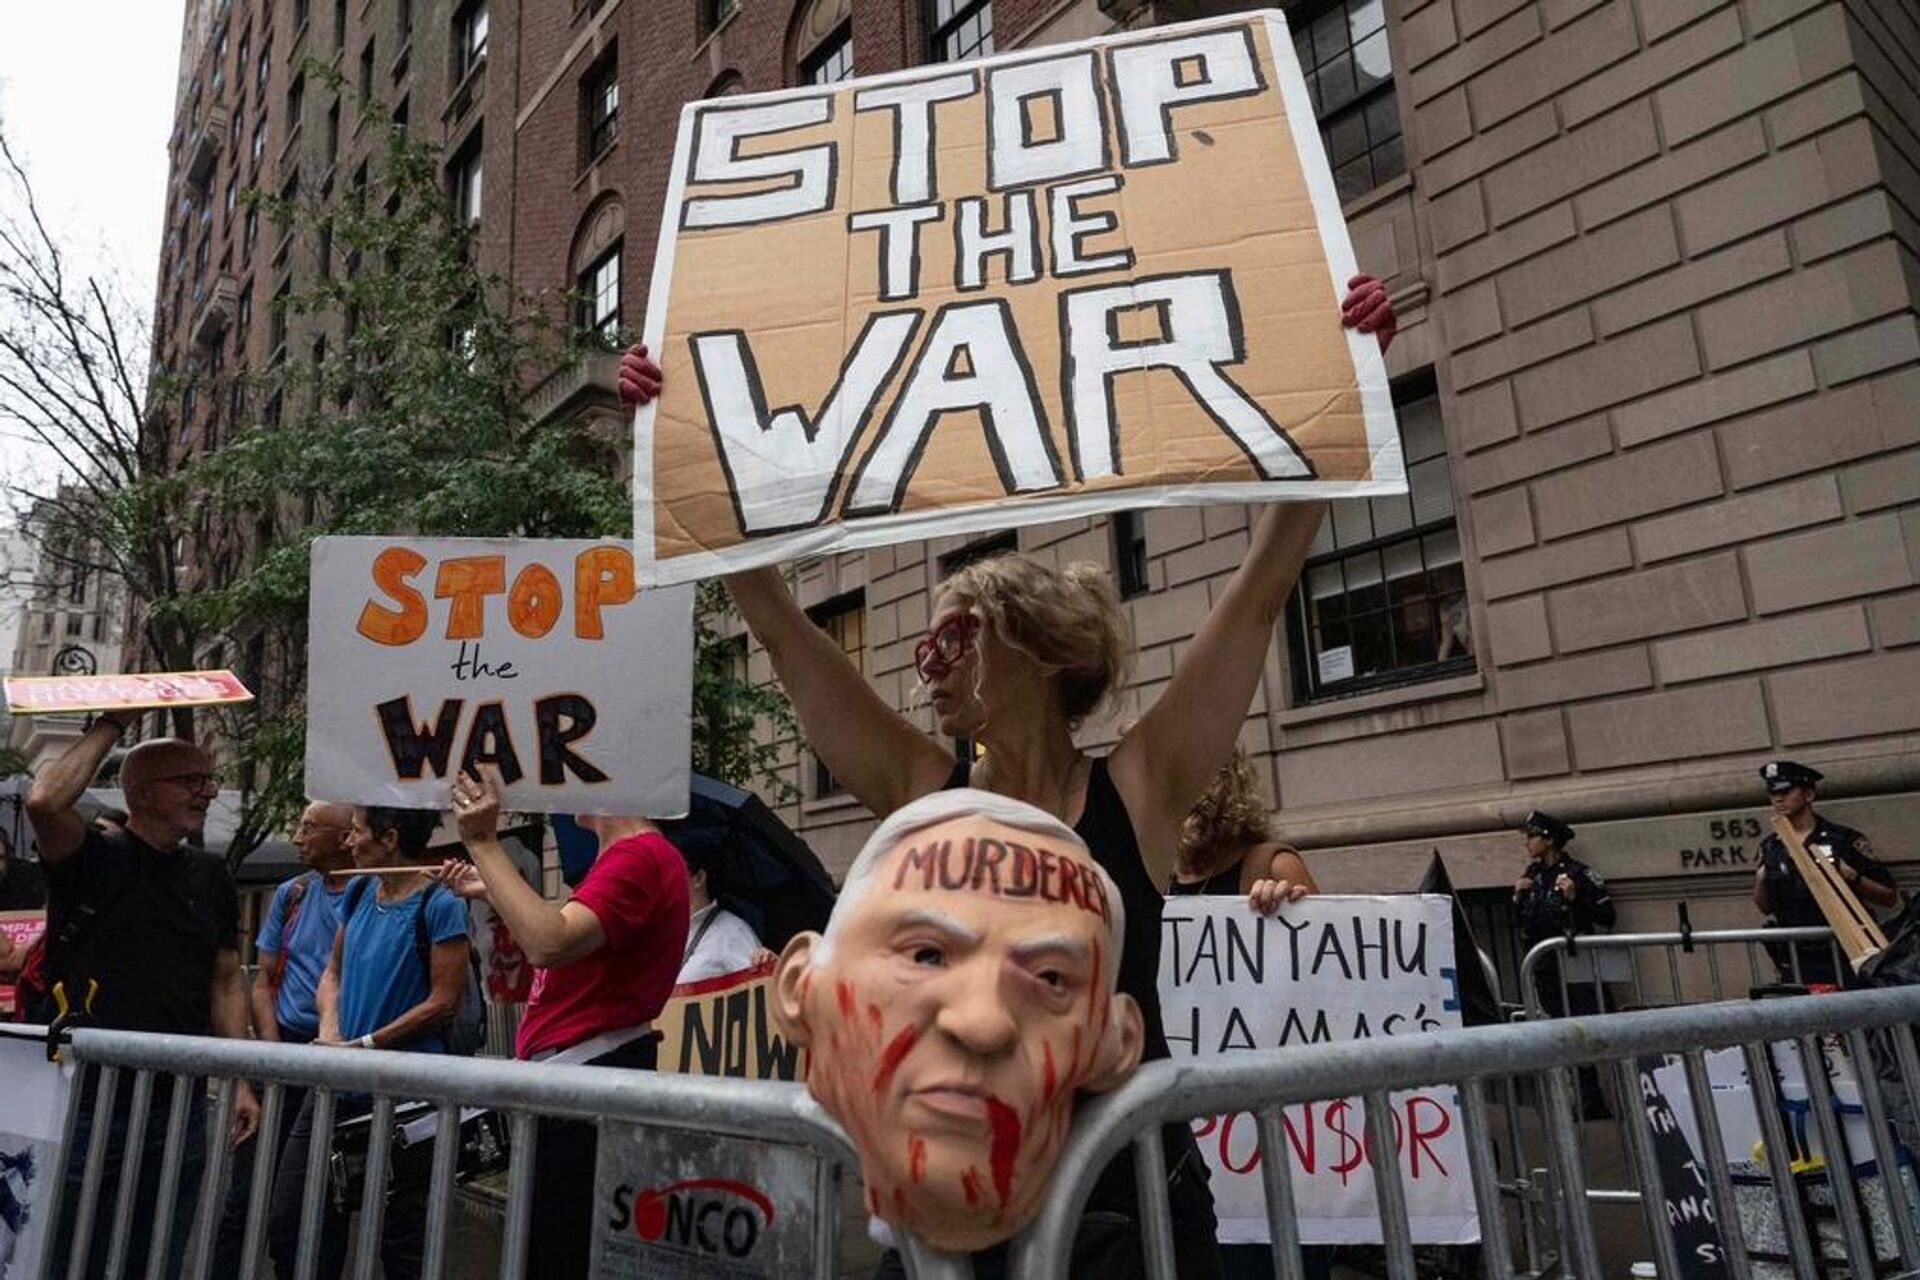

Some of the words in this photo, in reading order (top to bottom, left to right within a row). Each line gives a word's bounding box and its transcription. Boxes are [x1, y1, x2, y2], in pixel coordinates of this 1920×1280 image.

[678, 24, 1268, 231] STOP
[848, 174, 1135, 301] THE
[687, 268, 1317, 537] WAR
[357, 546, 636, 646] STOP
[451, 641, 518, 680] the
[376, 694, 612, 785] WAR
[1681, 846, 1747, 867] PARK
[1710, 818, 1761, 840] 563
[679, 986, 799, 1081] NOW
[610, 1184, 757, 1257] SONCO
